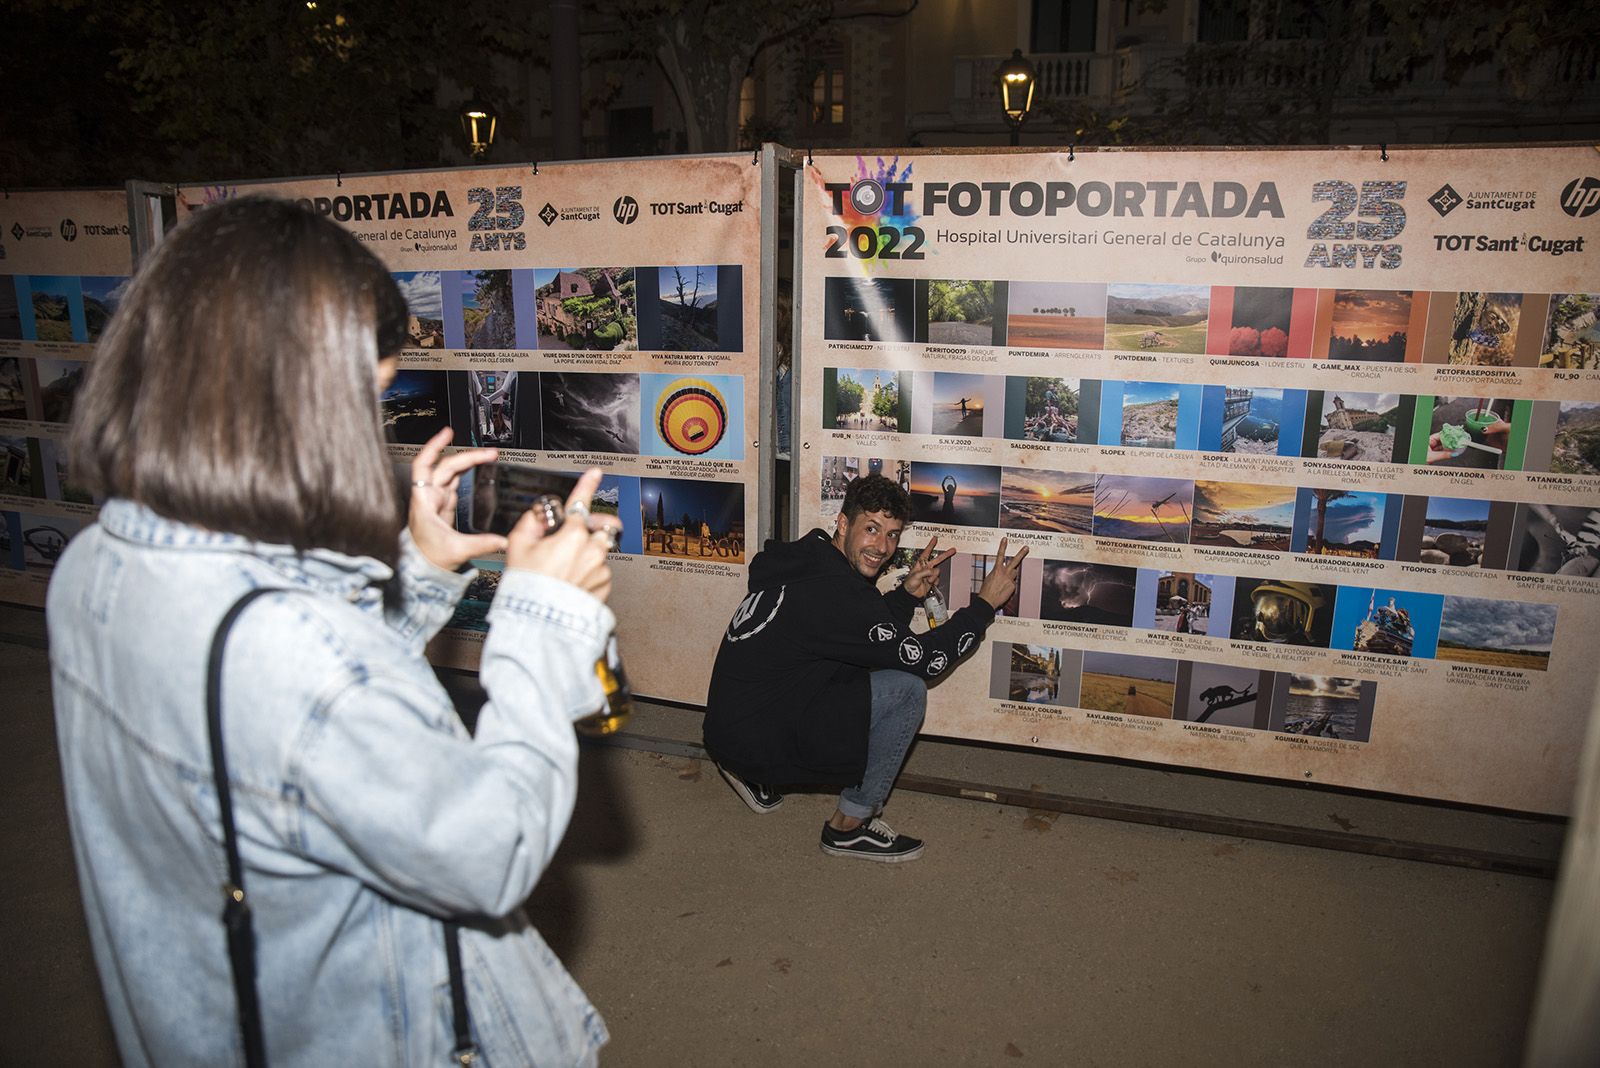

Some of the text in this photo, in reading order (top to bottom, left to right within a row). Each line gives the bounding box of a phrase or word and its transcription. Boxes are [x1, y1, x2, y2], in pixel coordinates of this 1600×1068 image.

[824, 179, 1285, 217] TOT FOTOPORTADA
[1468, 191, 1537, 199] AJUNTAMENT DE
[1560, 177, 1600, 218] hp
[467, 186, 526, 231] 25
[613, 196, 639, 224] hp
[1306, 180, 1407, 241] 25
[1466, 199, 1535, 211] SantCugat
[561, 212, 600, 221] SantCugat
[391, 229, 402, 239] de
[405, 229, 456, 242] Catalunya
[469, 232, 527, 251] ANYS
[937, 229, 1285, 250] Hospital Universitari General de Catalunya
[825, 226, 925, 260] 2022
[1186, 255, 1206, 264] Grupo
[1304, 244, 1403, 269] ANYS
[1313, 363, 1360, 371] R_GAME_MAX
[1437, 369, 1516, 377] RETOFRASEPOSITIVA
[1434, 376, 1522, 385] #TOTFOTOPORTADA2022
[1303, 461, 1371, 471] SONYASONYADORA
[1413, 469, 1485, 479] SONYASONYADORA
[1526, 476, 1572, 484] TATANKA35
[912, 525, 957, 534] THEALUPLANET
[1006, 532, 1052, 540] THEALUPLANET
[1194, 548, 1280, 560] TINALABRADORCARRASCO
[1294, 556, 1384, 569] TINALABRADORCARRASCO
[1401, 565, 1436, 574] TTGOPICS
[1341, 654, 1408, 665] WHAT.THE.EYE.SAW
[1452, 665, 1523, 678] WHAT.THE.EYE.SAW
